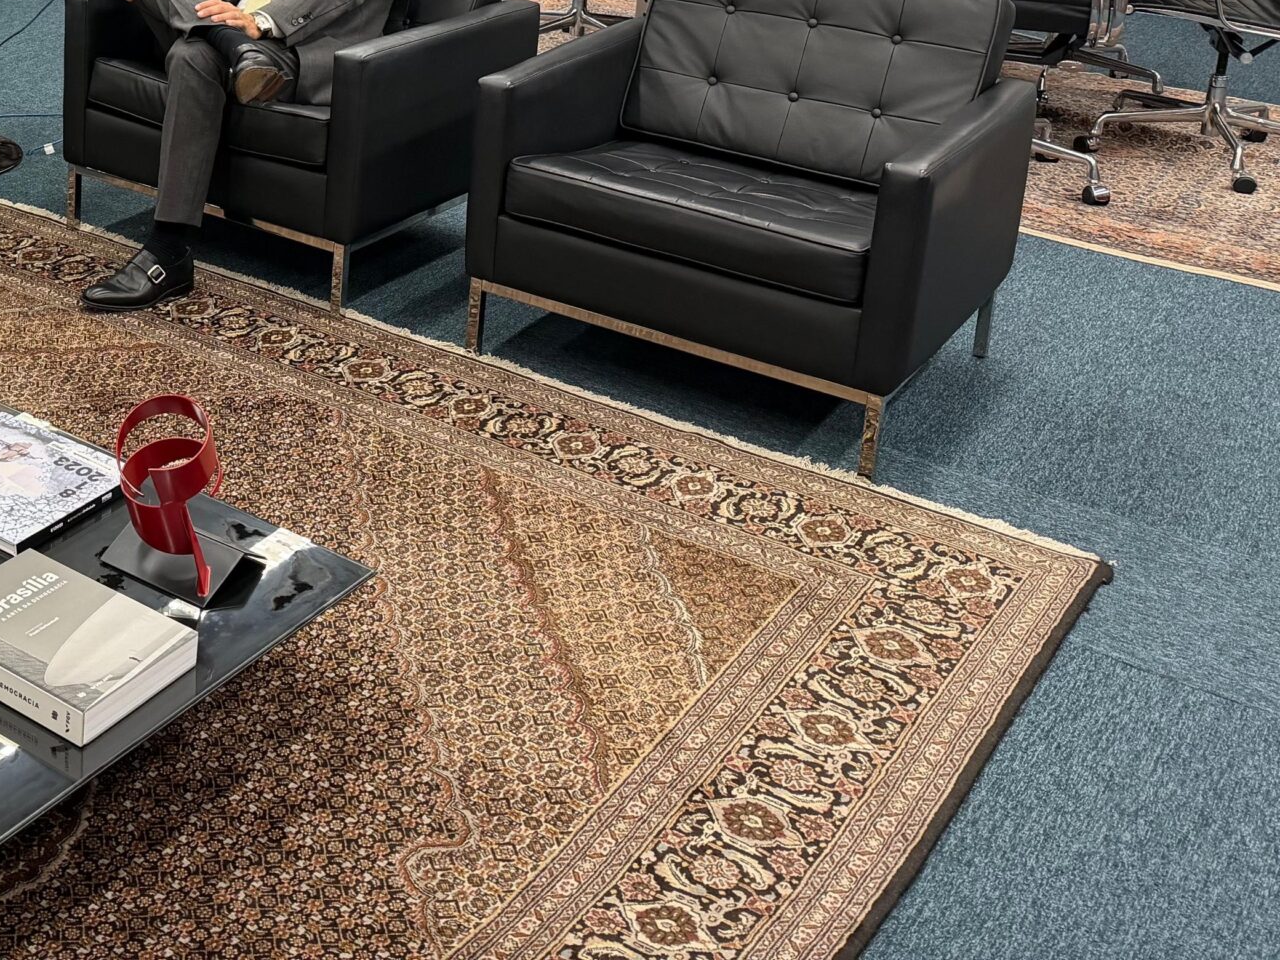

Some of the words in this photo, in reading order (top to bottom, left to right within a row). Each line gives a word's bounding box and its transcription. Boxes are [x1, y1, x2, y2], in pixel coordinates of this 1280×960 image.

[53, 456, 106, 482] 2023
[7, 608, 22, 619] ARTE
[31, 580, 68, 603] DEMOCRACIA
